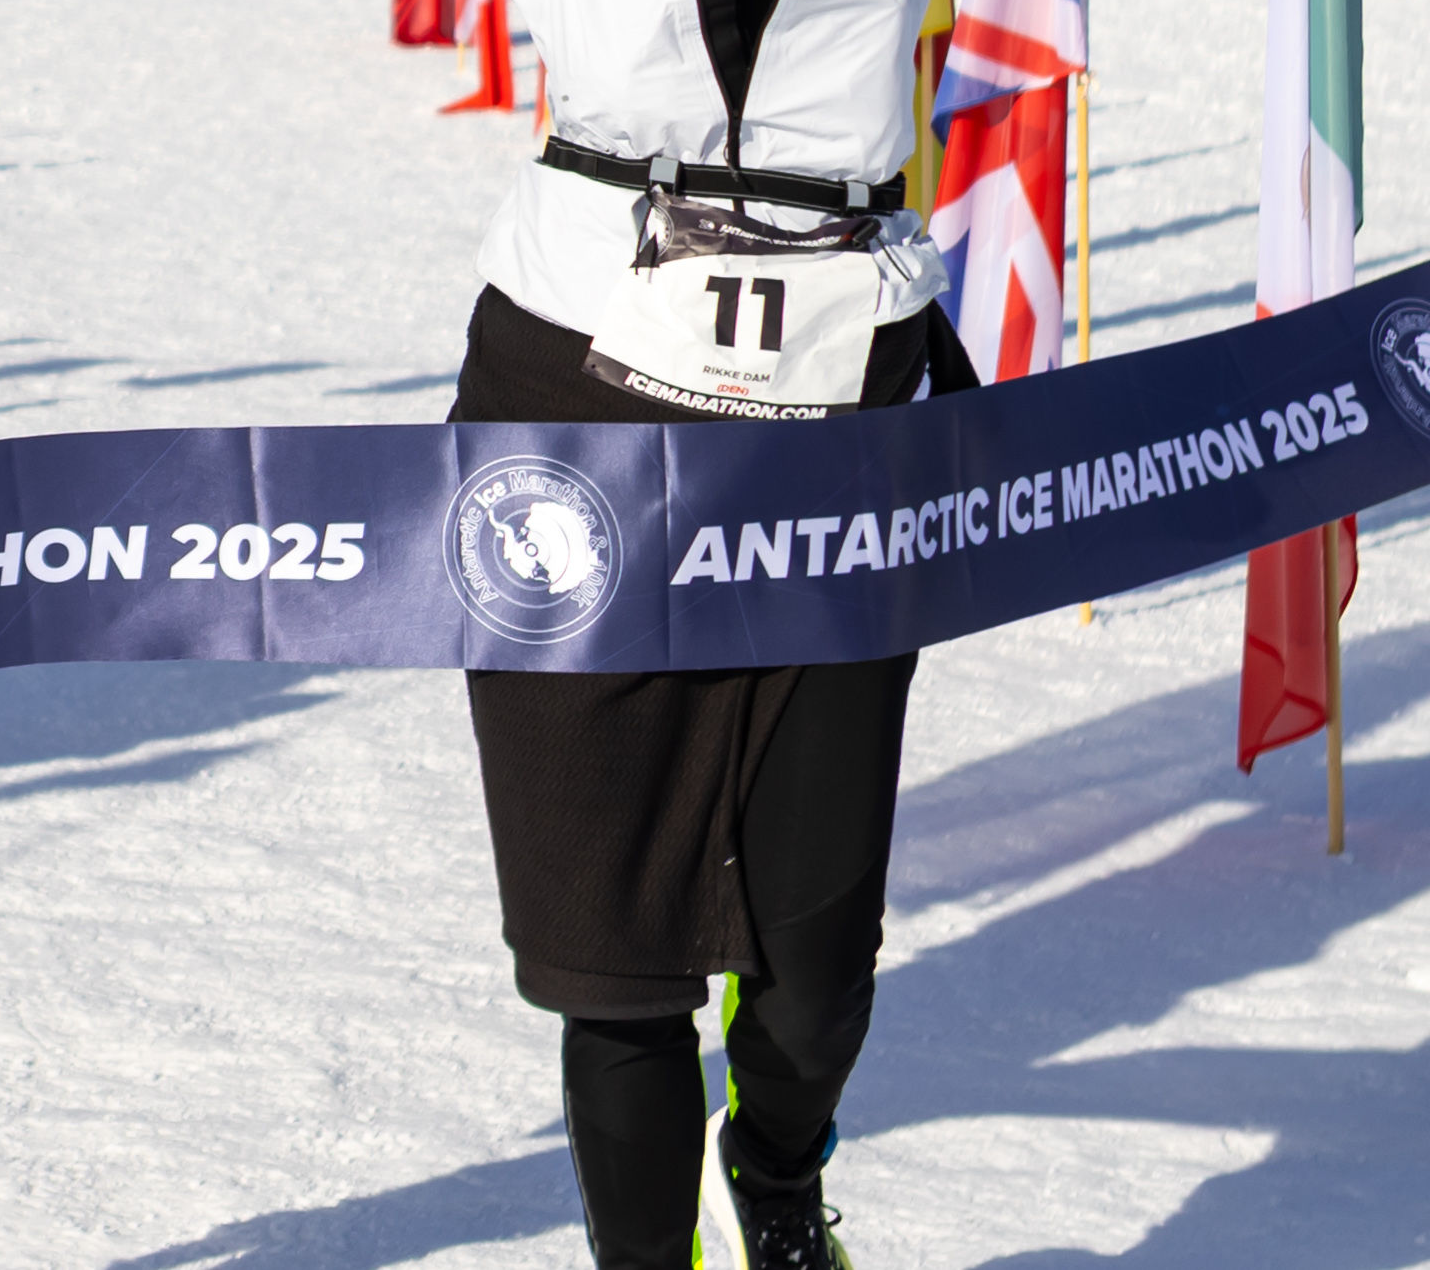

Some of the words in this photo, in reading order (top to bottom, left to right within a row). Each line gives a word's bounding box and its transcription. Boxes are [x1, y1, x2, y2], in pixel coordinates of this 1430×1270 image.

[705, 275, 786, 352] 11
[624, 371, 828, 420] ICEMARATHON.COM
[702, 365, 741, 379] RIKKE
[743, 372, 771, 383] DAM
[717, 384, 750, 396] (DEN)
[473, 480, 507, 509] Ice
[508, 470, 598, 529] Marathon
[670, 484, 990, 585] ANTARCTIC
[998, 469, 1054, 539] ICE
[1062, 419, 1264, 524] MARATHON
[1261, 382, 1370, 460] 2025
[169, 523, 366, 581] 2025
[459, 507, 499, 604] Antarctic
